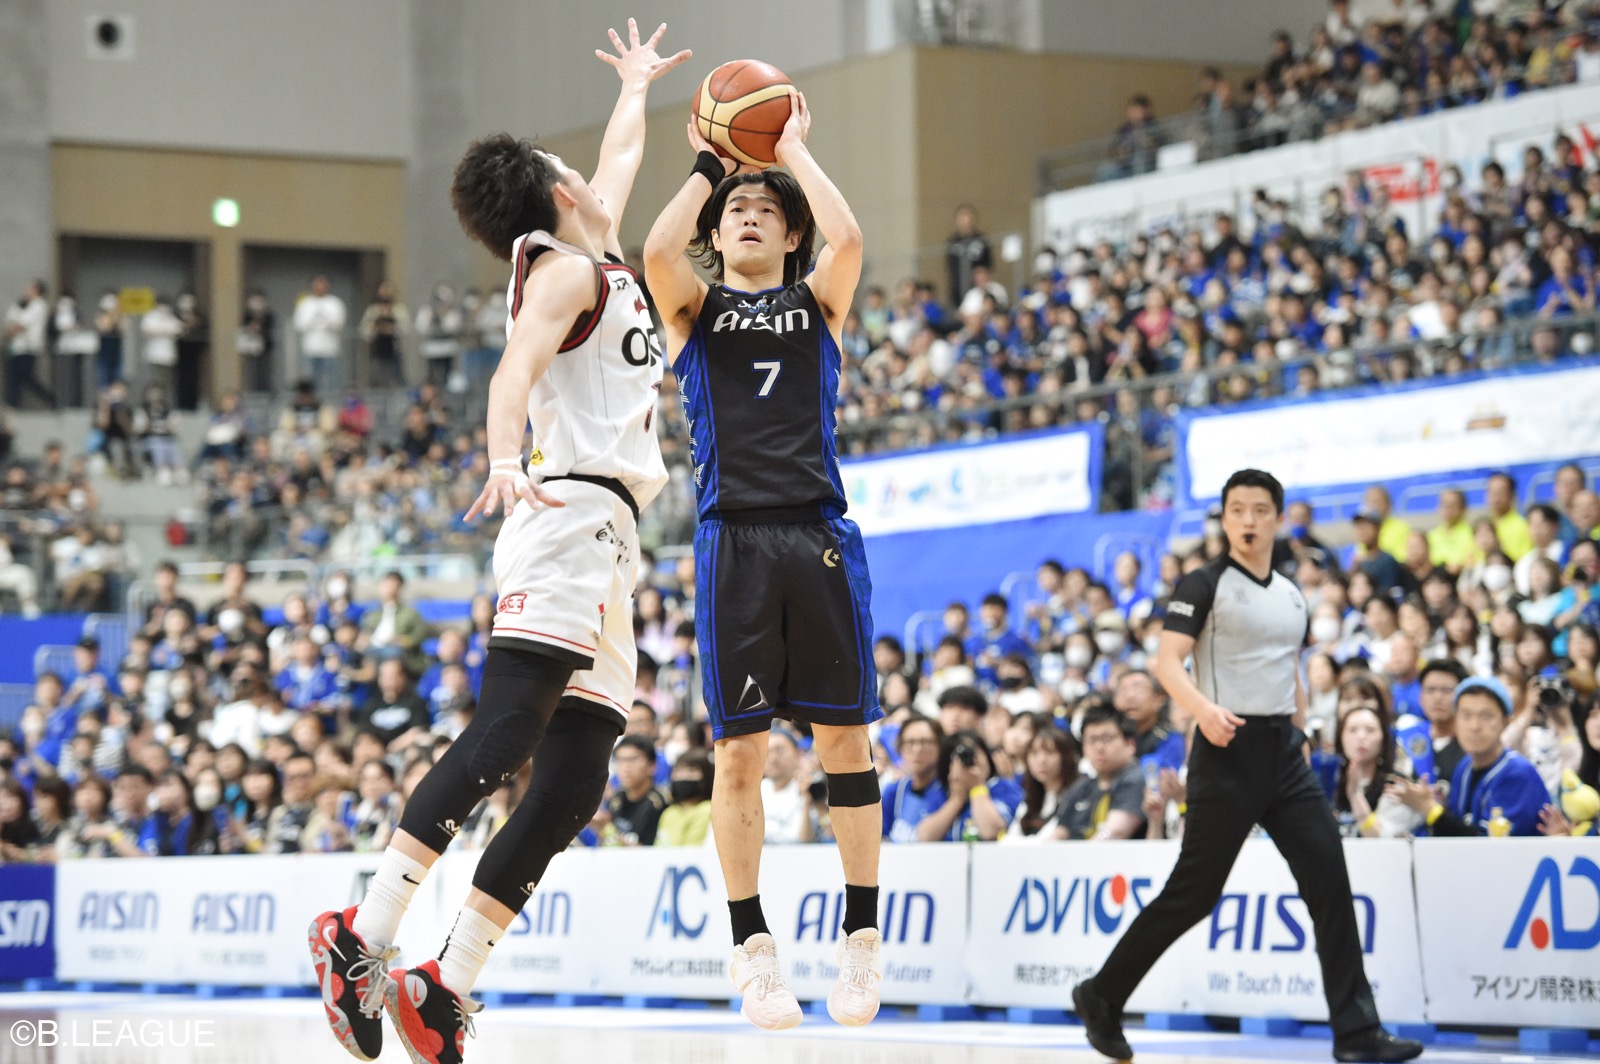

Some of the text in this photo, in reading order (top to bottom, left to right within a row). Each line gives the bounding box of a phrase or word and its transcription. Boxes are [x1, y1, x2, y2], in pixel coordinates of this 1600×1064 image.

[713, 308, 809, 334] AISIN
[753, 360, 782, 398] 7
[0, 899, 50, 948] SIN
[78, 891, 158, 930] AISIN
[191, 892, 276, 932] AISIN
[511, 891, 571, 935] SIN
[796, 892, 934, 943] AIIN
[1208, 894, 1375, 953] AISN
[816, 960, 839, 978] Tou
[1208, 971, 1316, 996] We Touch the
[1471, 975, 1600, 1003] アイシン開発株
